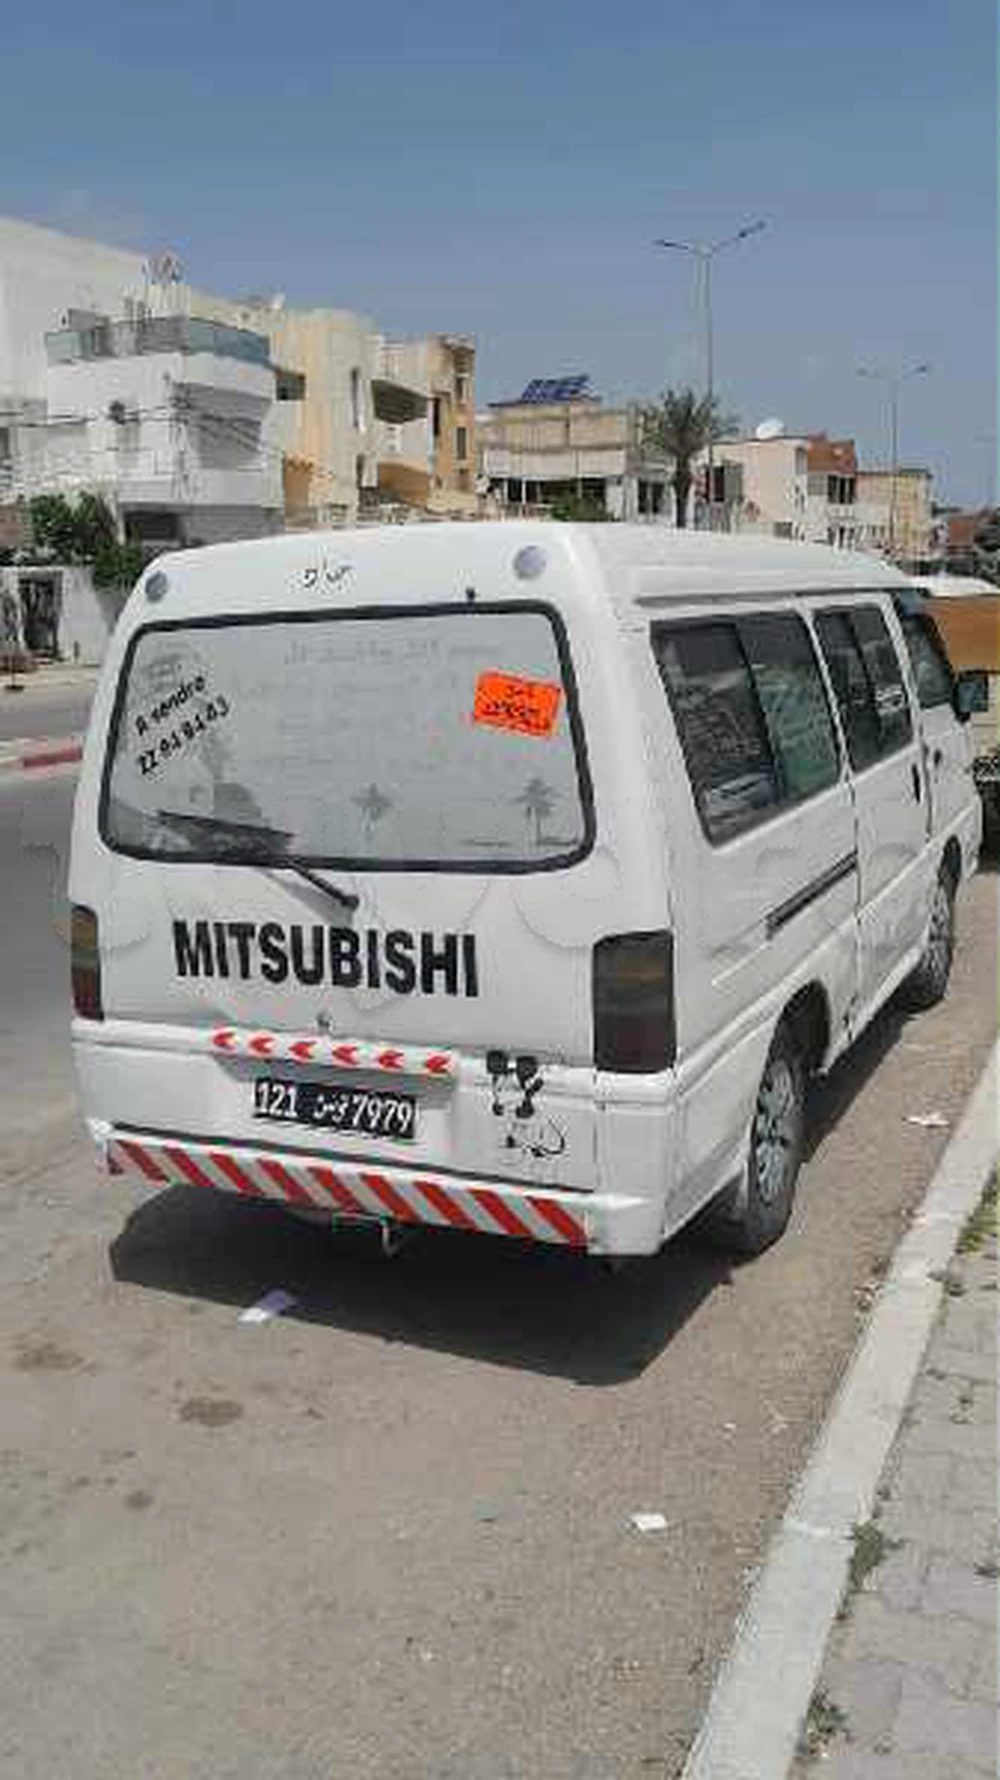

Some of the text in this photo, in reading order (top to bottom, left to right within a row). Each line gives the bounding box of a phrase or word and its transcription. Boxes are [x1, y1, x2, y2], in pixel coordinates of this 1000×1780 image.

[172, 920, 479, 998] MITSUBISHI
[256, 1082, 298, 1118] 121
[351, 1093, 413, 1133] 7979
